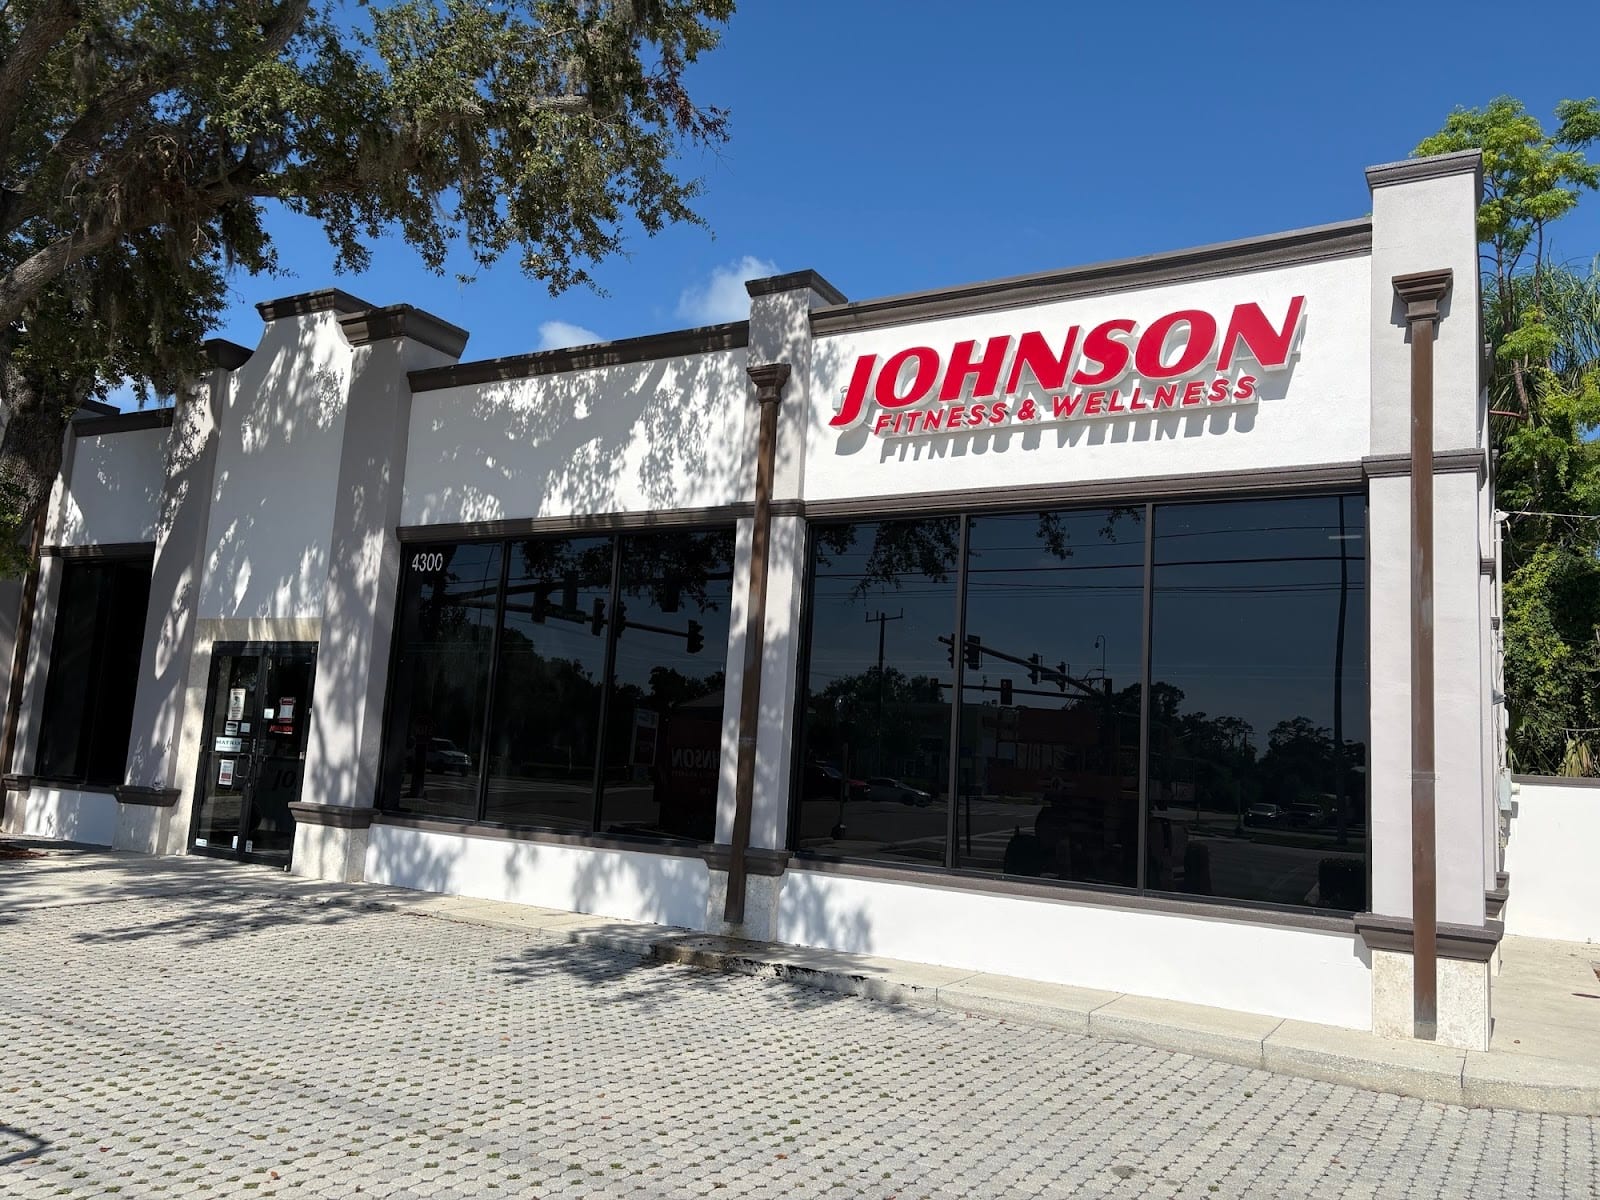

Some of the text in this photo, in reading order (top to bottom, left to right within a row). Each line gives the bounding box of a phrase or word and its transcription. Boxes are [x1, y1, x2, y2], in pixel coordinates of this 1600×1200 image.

[829, 295, 1303, 426] JOHNSON
[875, 376, 1255, 435] FITNESS & WELLNESS
[411, 552, 444, 572] 4300
